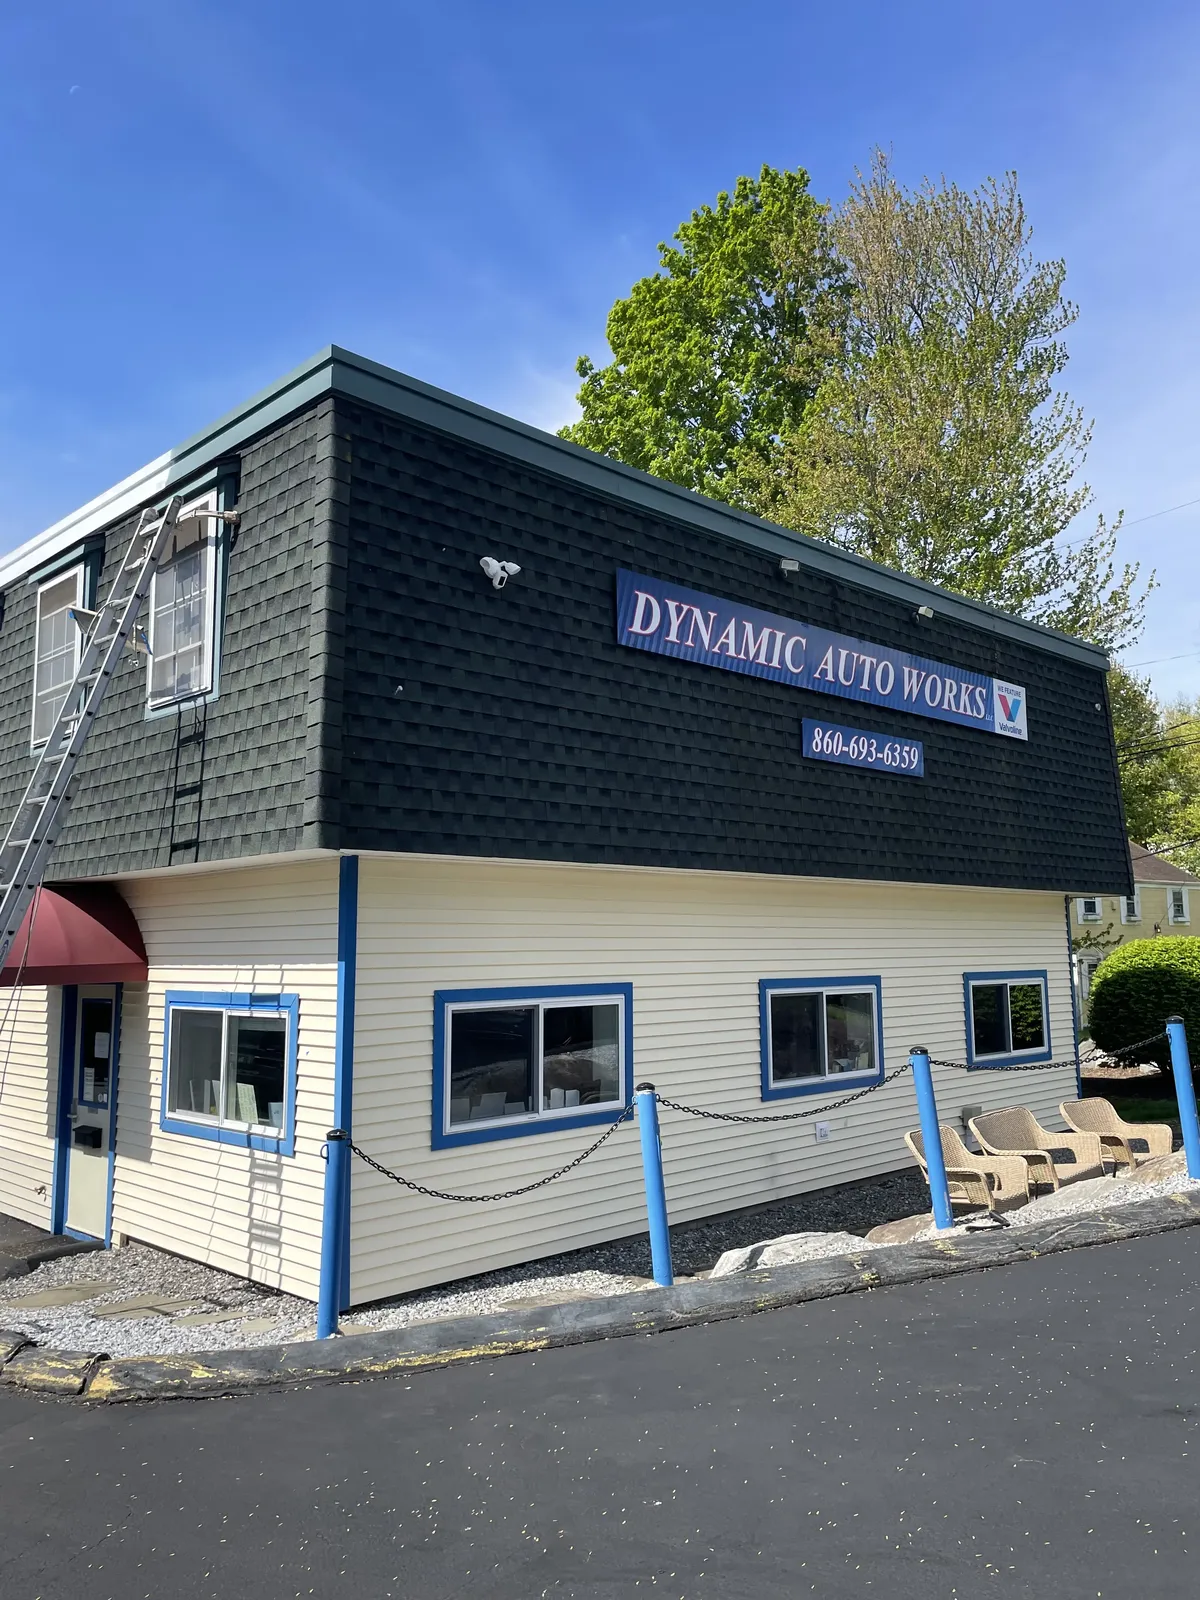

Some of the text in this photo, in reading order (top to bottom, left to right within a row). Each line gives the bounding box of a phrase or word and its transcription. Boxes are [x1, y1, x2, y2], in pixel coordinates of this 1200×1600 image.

[628, 590, 807, 674] DYNAMIC
[813, 645, 896, 696] AUTO
[902, 666, 987, 719] WORKS
[997, 685, 1022, 698] WE FEATURE
[998, 722, 1022, 735] Valvoline
[812, 727, 919, 770] 860-693-6359
